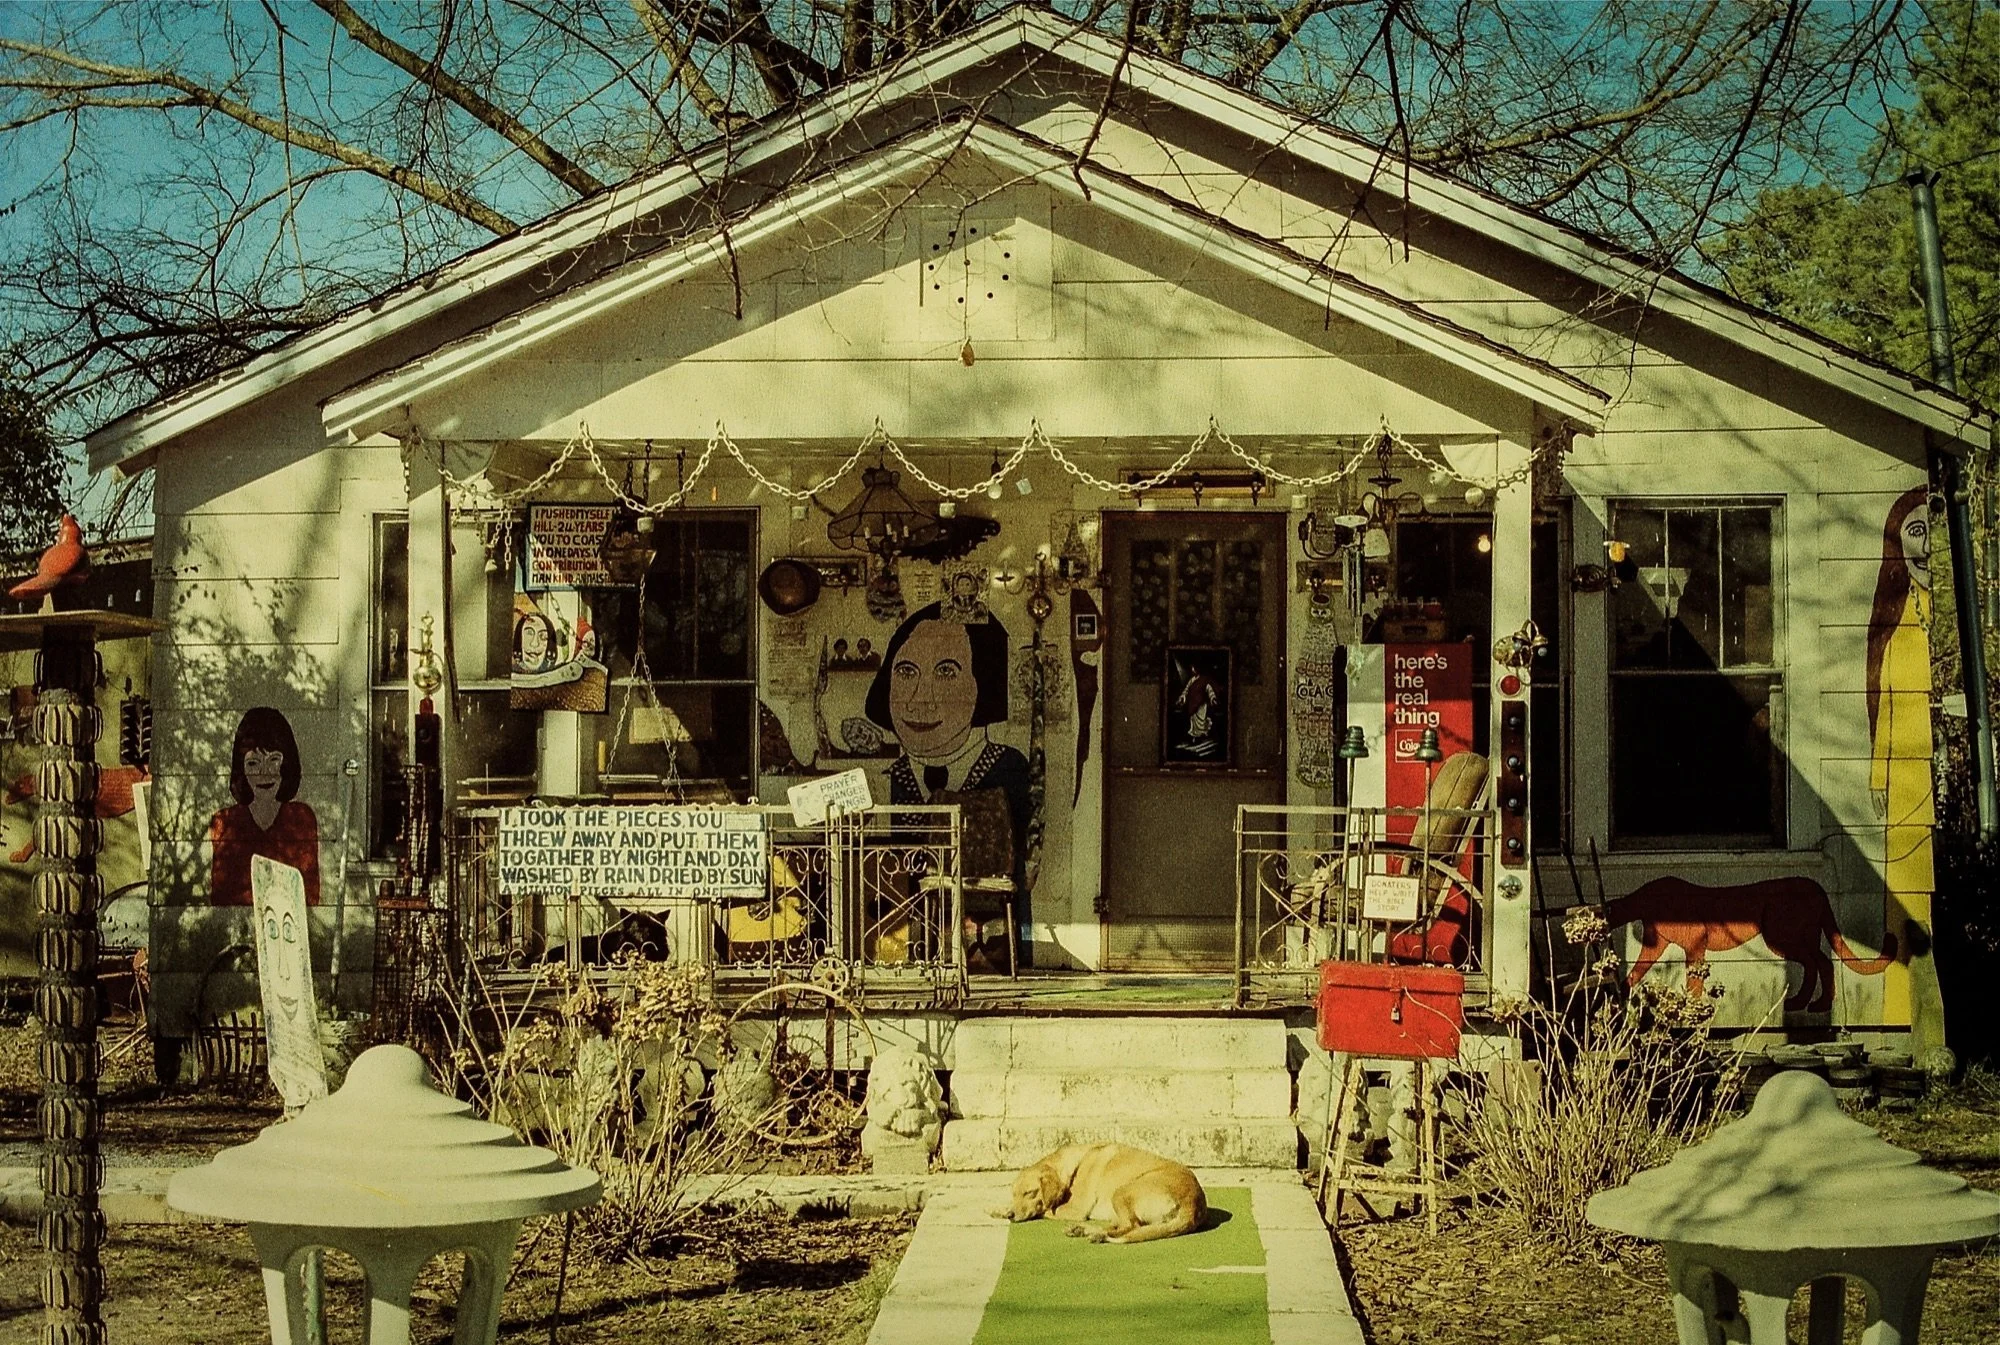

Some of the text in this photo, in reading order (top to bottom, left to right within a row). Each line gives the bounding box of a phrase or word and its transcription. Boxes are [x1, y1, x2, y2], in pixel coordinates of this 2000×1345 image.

[534, 535, 554, 545] YOU
[556, 535, 570, 545] TO
[533, 547, 543, 558] IN
[1394, 653, 1448, 670] here's
[1394, 672, 1424, 688] the
[1395, 689, 1429, 705] real
[1394, 708, 1440, 728] thing
[820, 775, 857, 793] PRAYER
[823, 785, 865, 804] CHANGES
[503, 810, 722, 829] I TOOK THE PIECES YOU
[501, 830, 758, 850] THREW AWAY AND PUT THEM
[501, 849, 760, 868] TOGATHER BY NIGHT AND DAY
[501, 868, 766, 885] WASHED BY RAIN DRIED BY SUN
[501, 887, 718, 896] A MILLION PIECES ALL IN ONE
